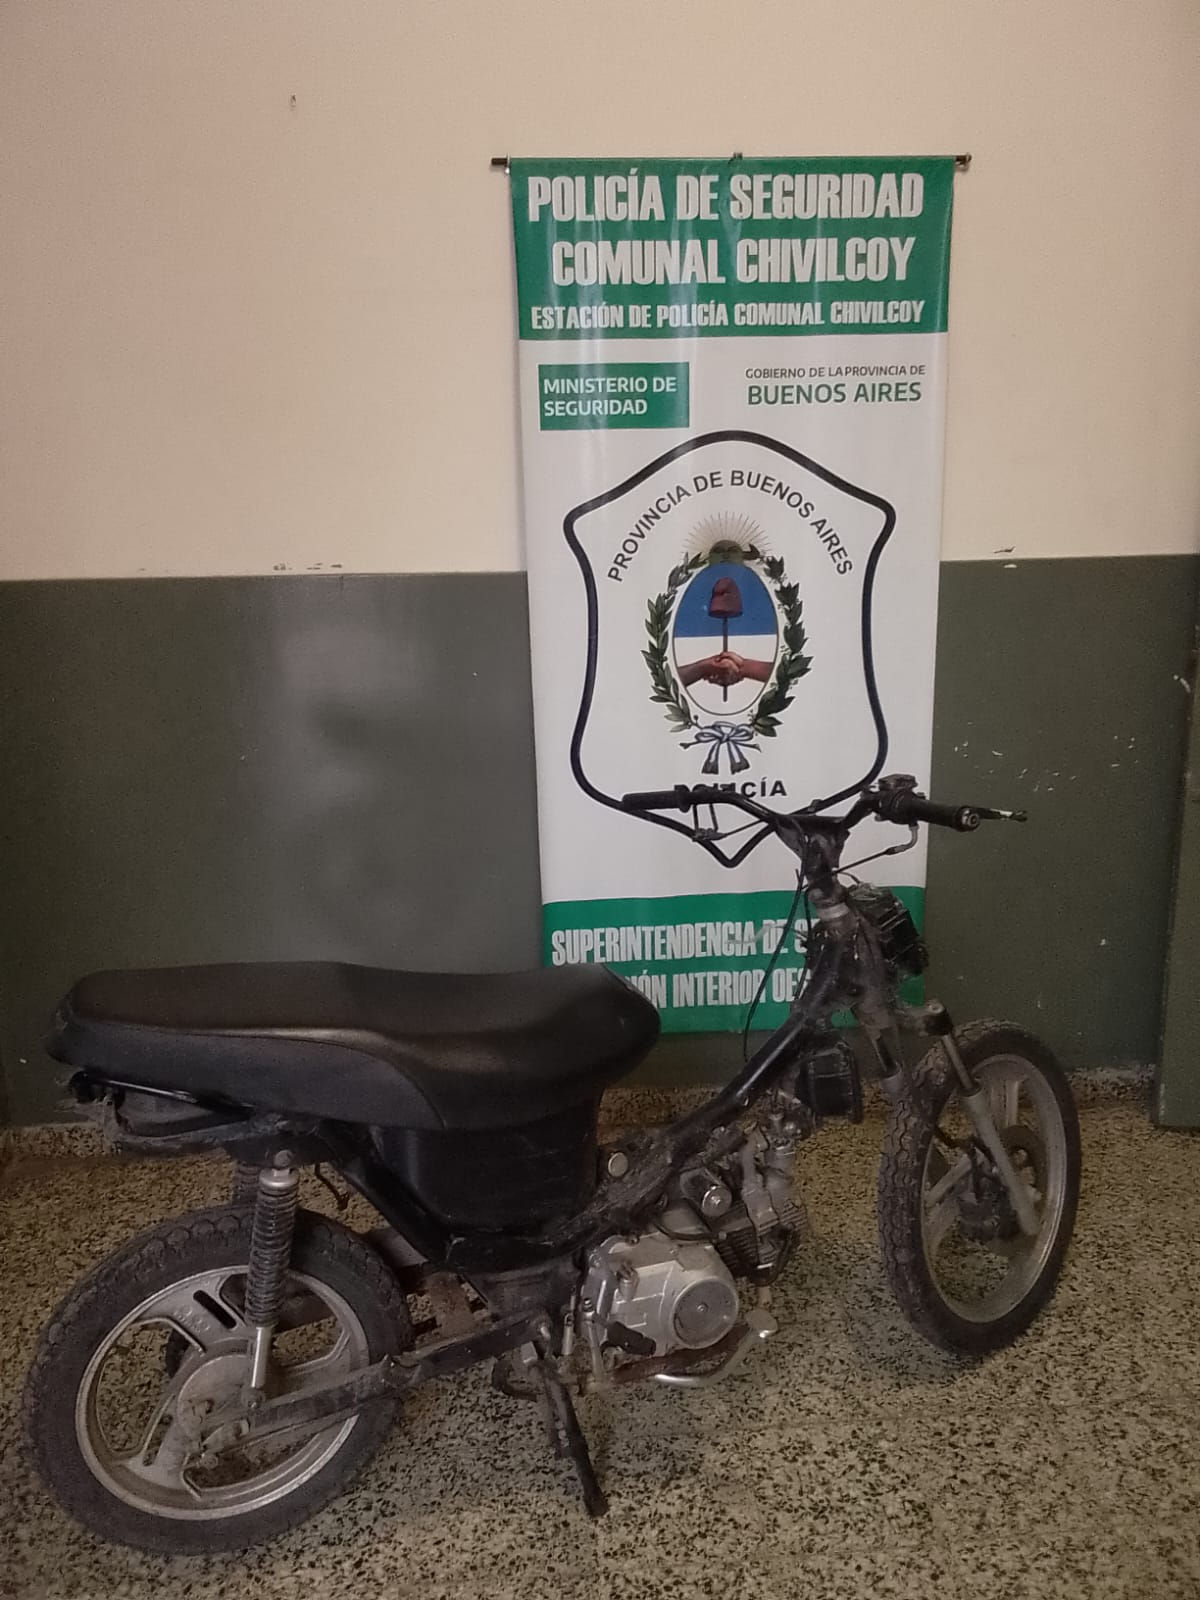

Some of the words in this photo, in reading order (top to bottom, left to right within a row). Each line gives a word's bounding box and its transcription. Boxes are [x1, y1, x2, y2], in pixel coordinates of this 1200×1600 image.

[528, 168, 665, 222] POLICÍA
[676, 175, 719, 219] DE
[730, 173, 924, 220] SEGURIDAD
[551, 239, 725, 286] COMUNAL
[736, 237, 916, 283] CHIVILCOY
[531, 302, 623, 329] ESTACIÓN
[628, 305, 652, 328] DE
[656, 300, 729, 328] POLICÍA
[734, 303, 824, 326] COMUNAL
[830, 301, 925, 325] CHIVILCOY
[543, 377, 648, 394] MINISTERIO
[652, 376, 677, 392] DE
[745, 367, 805, 379] GOBIERNO
[809, 366, 825, 377] DE
[828, 367, 843, 377] LA
[844, 366, 907, 376] PROVINCIA
[909, 364, 926, 375] DE
[747, 384, 846, 405] BUENOS
[853, 382, 922, 402] AIRES
[544, 400, 648, 417] SEGURIDAD
[607, 485, 692, 582] PROVINCIA
[693, 471, 723, 493] DE
[731, 470, 816, 519] BUENOS
[810, 518, 853, 576] AIRES
[551, 921, 757, 966] SUPERINTENDENCIA
